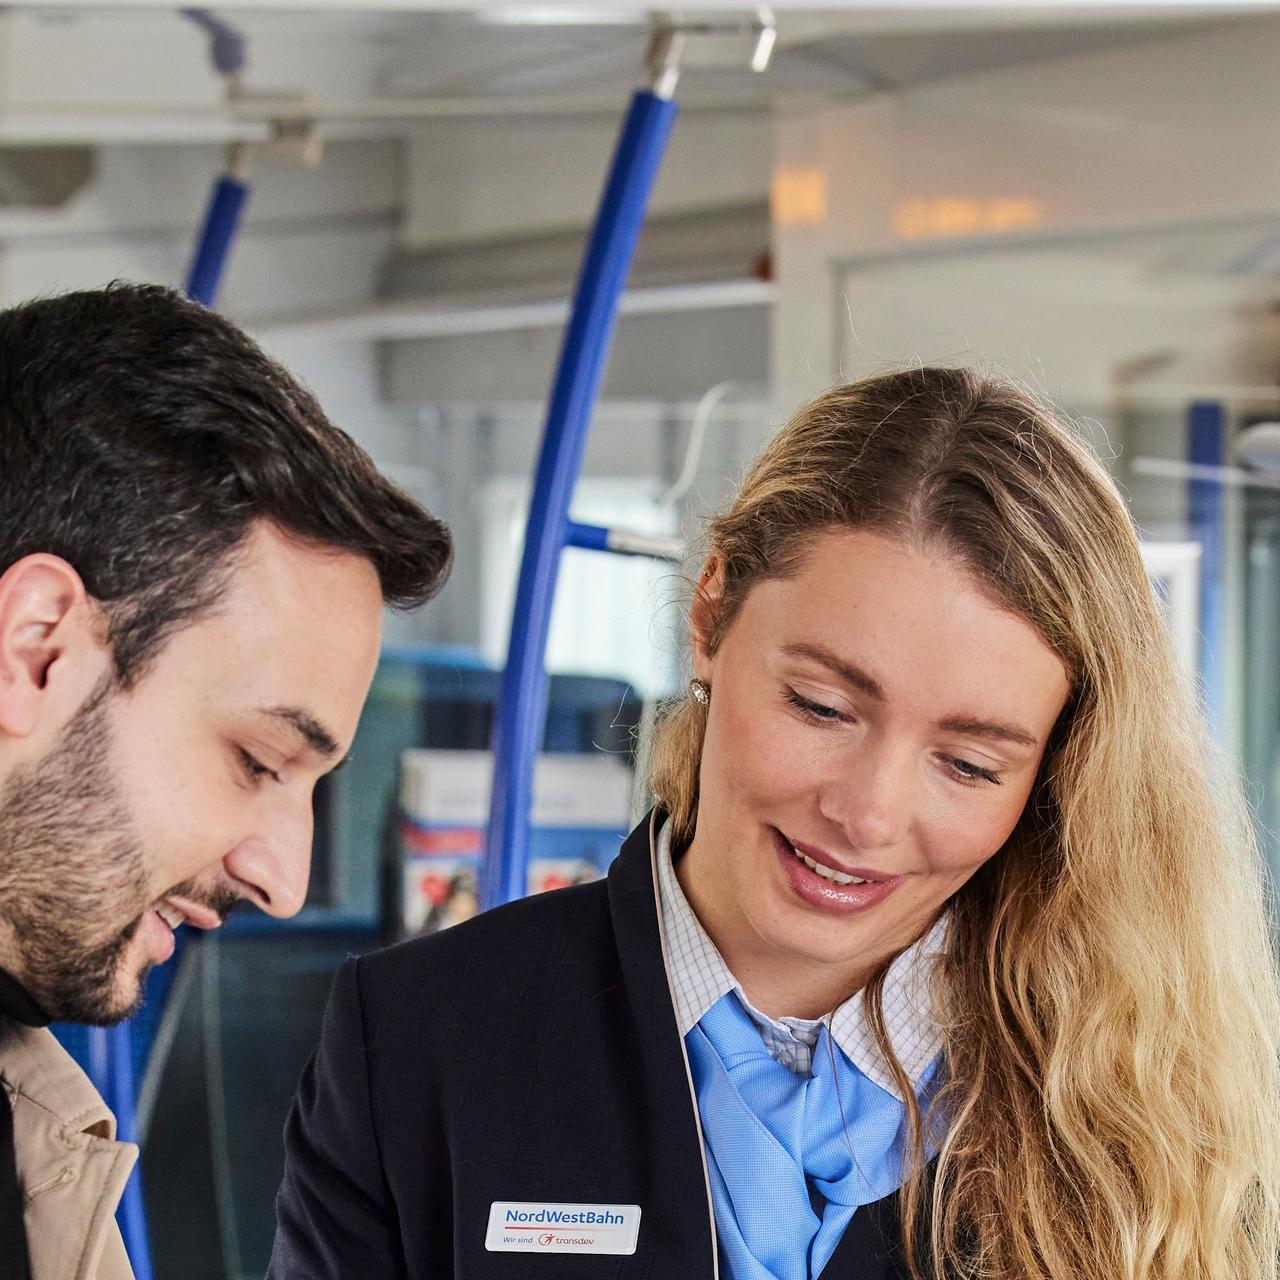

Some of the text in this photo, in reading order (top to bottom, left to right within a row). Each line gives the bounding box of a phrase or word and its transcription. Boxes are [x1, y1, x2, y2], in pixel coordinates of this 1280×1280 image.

[505, 1209, 625, 1225] NordWestBahn
[517, 1236, 534, 1244] sind
[556, 1236, 595, 1246] transdev
